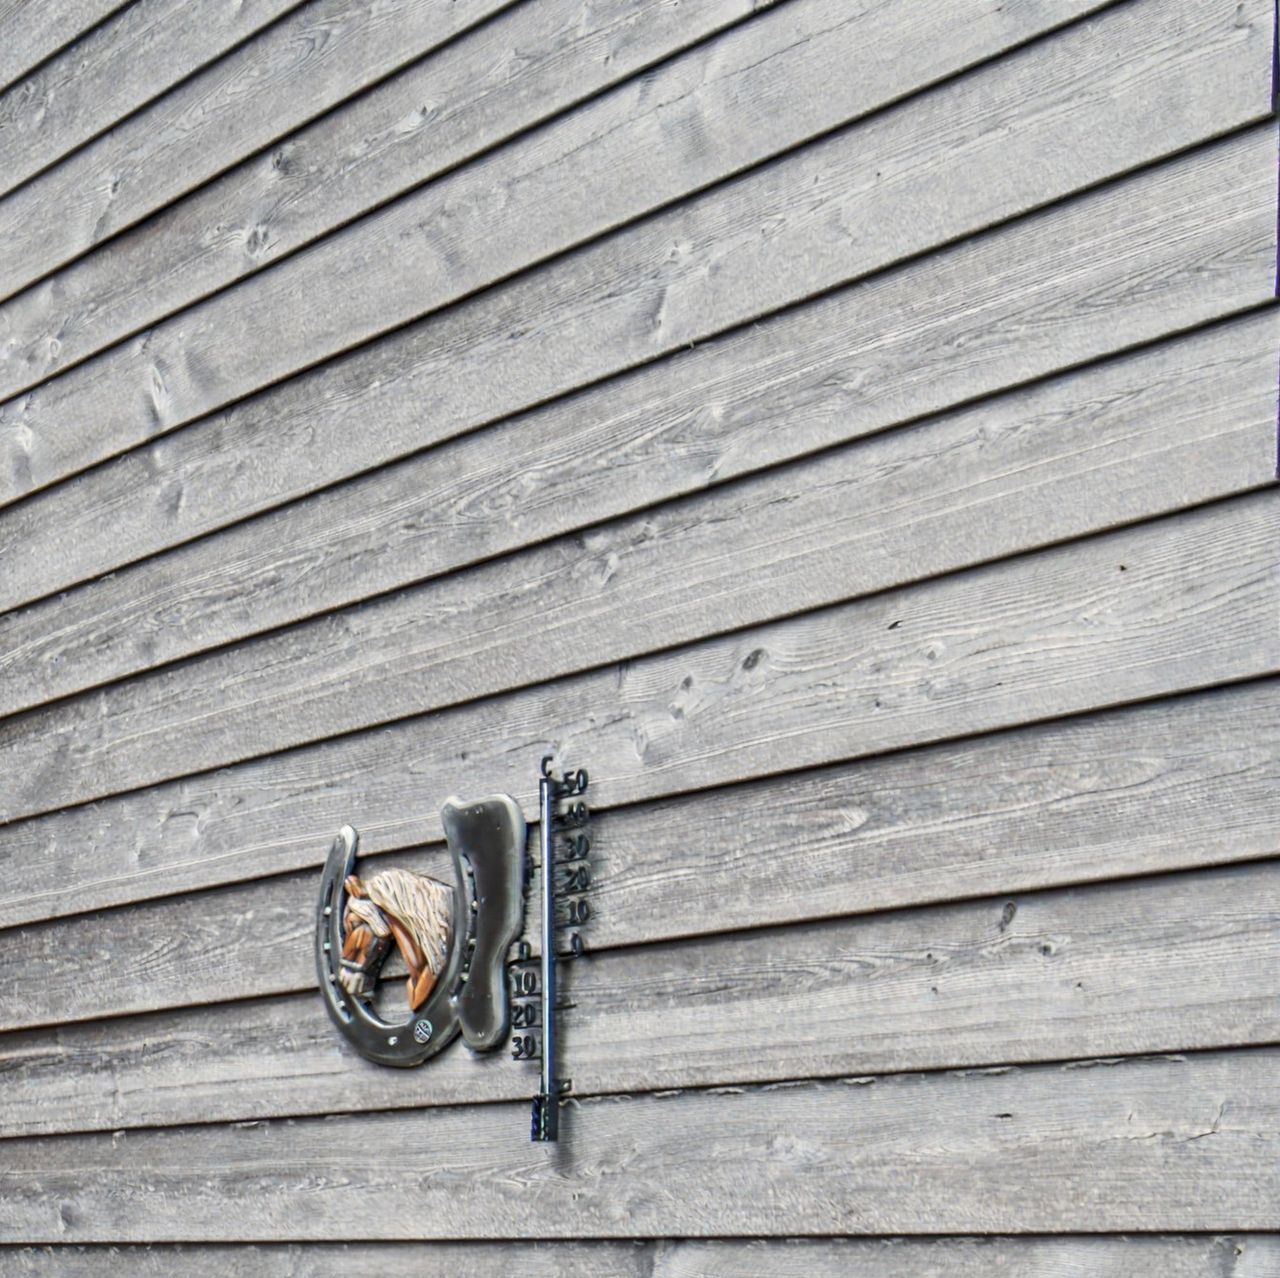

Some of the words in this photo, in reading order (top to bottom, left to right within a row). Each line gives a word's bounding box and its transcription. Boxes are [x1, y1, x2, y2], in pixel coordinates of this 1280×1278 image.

[563, 768, 589, 795] 50
[566, 833, 590, 860] 30
[564, 866, 590, 892] 20
[569, 899, 590, 922] 10
[513, 972, 537, 995] 10
[512, 1004, 537, 1027] 20
[511, 1035, 537, 1059] 30
